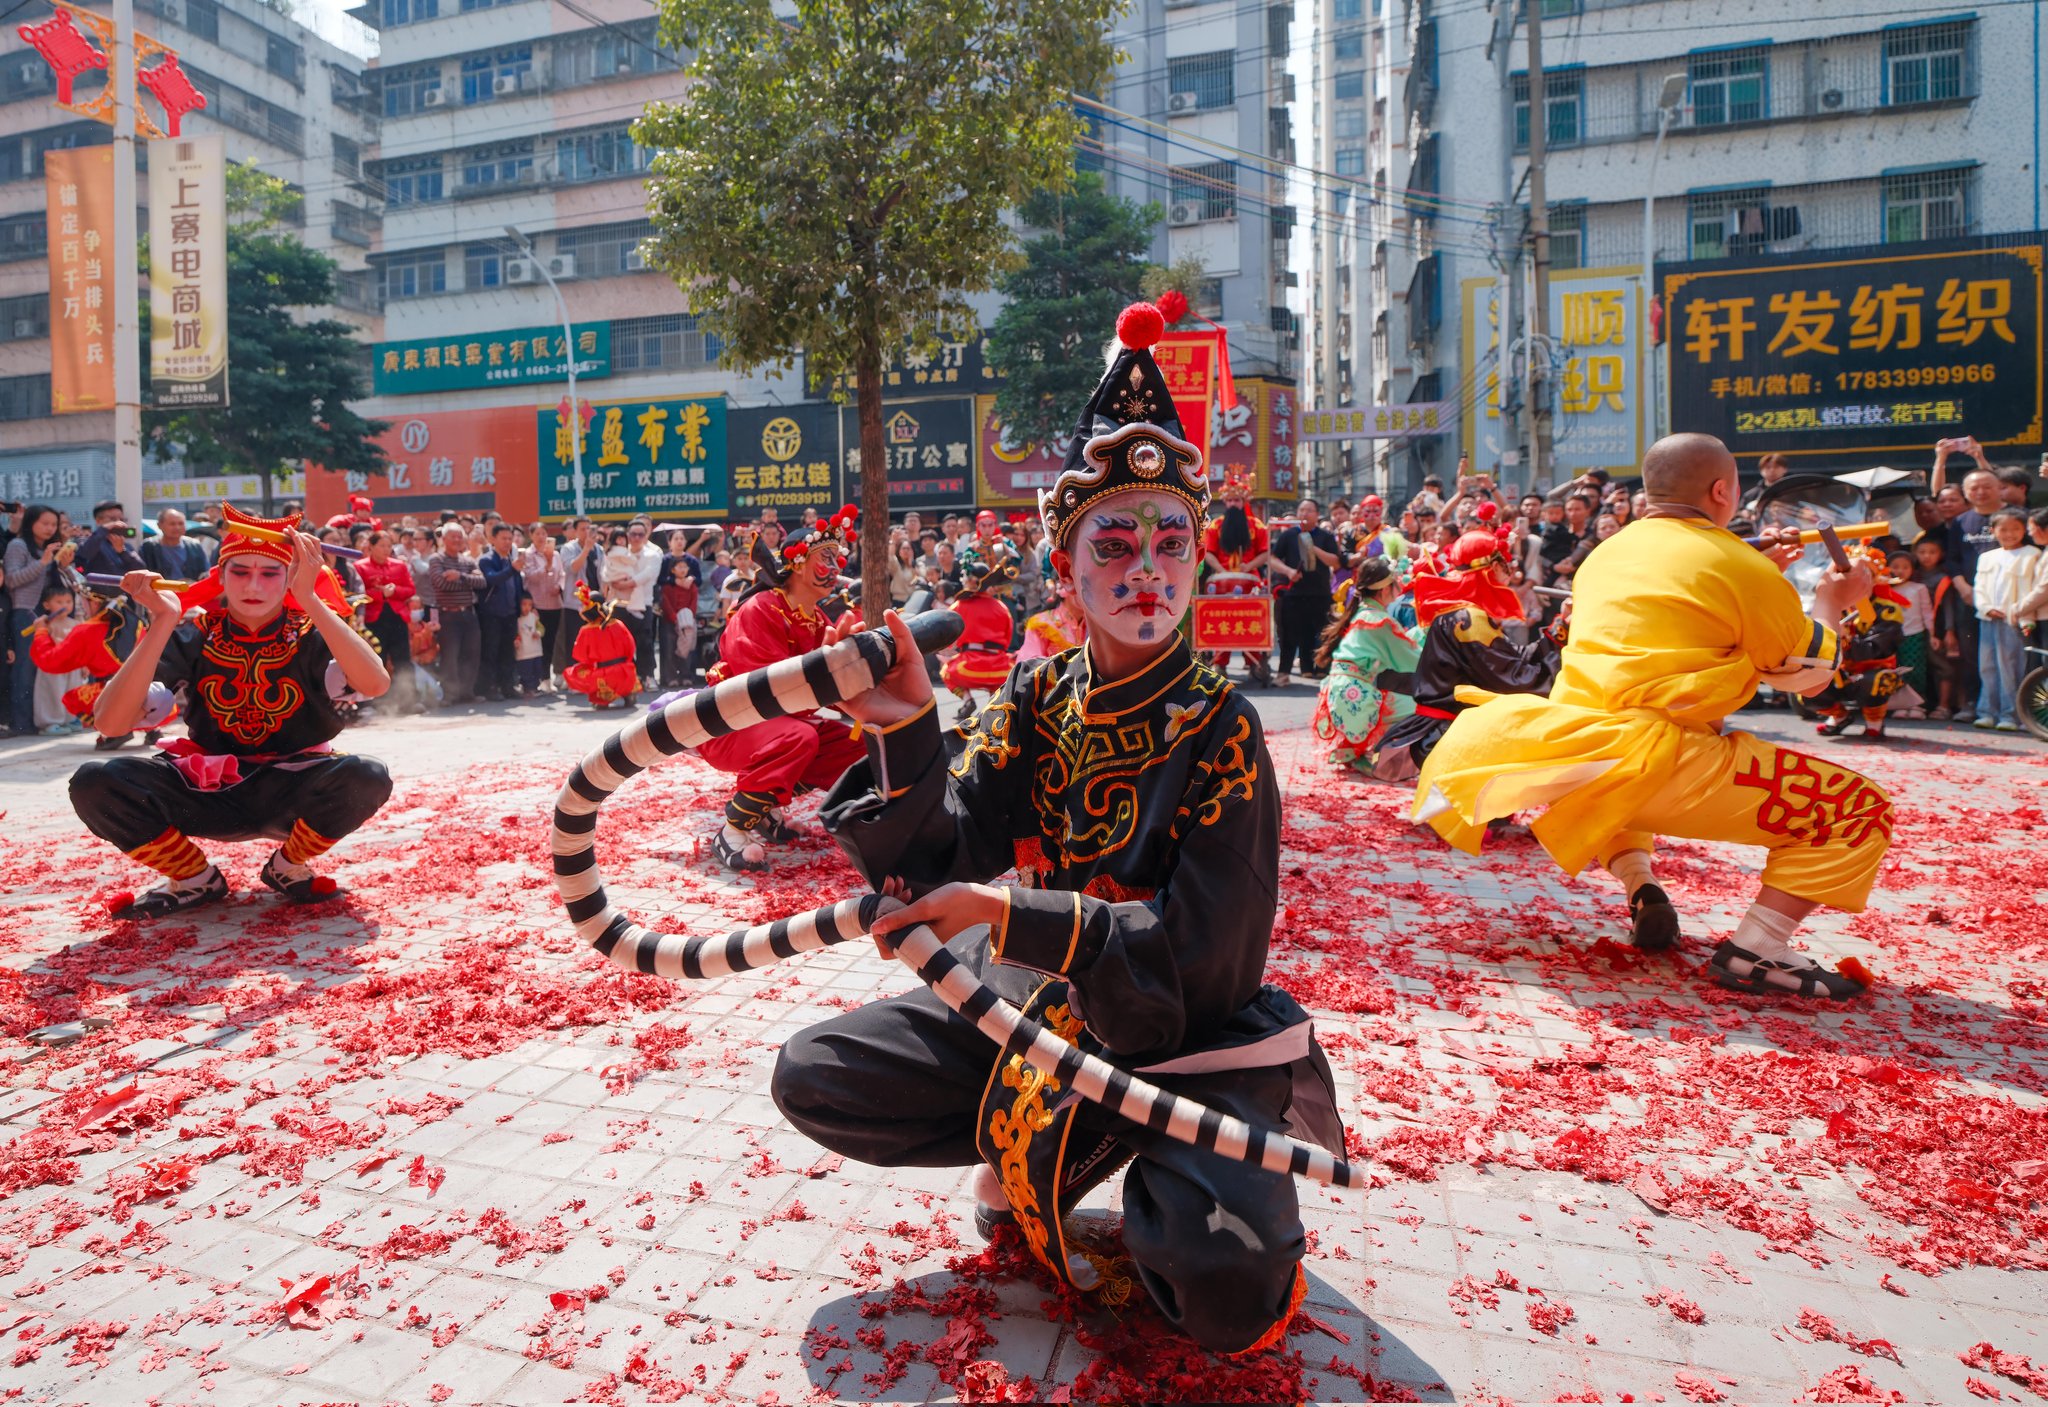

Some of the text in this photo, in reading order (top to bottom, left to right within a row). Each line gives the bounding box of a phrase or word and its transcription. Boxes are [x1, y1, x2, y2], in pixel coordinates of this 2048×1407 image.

[60, 184, 80, 319] 锚定百千万
[84, 229, 104, 365] 争当排头兵
[1685, 279, 2016, 363] 轩发纺织
[1836, 364, 1996, 391] 17833999966
[0, 469, 80, 500] 業纺织
[636, 467, 705, 487] 欢迎惠顾
[734, 461, 831, 490] 云武拉链
[547, 496, 637, 512] TEL:1766739111
